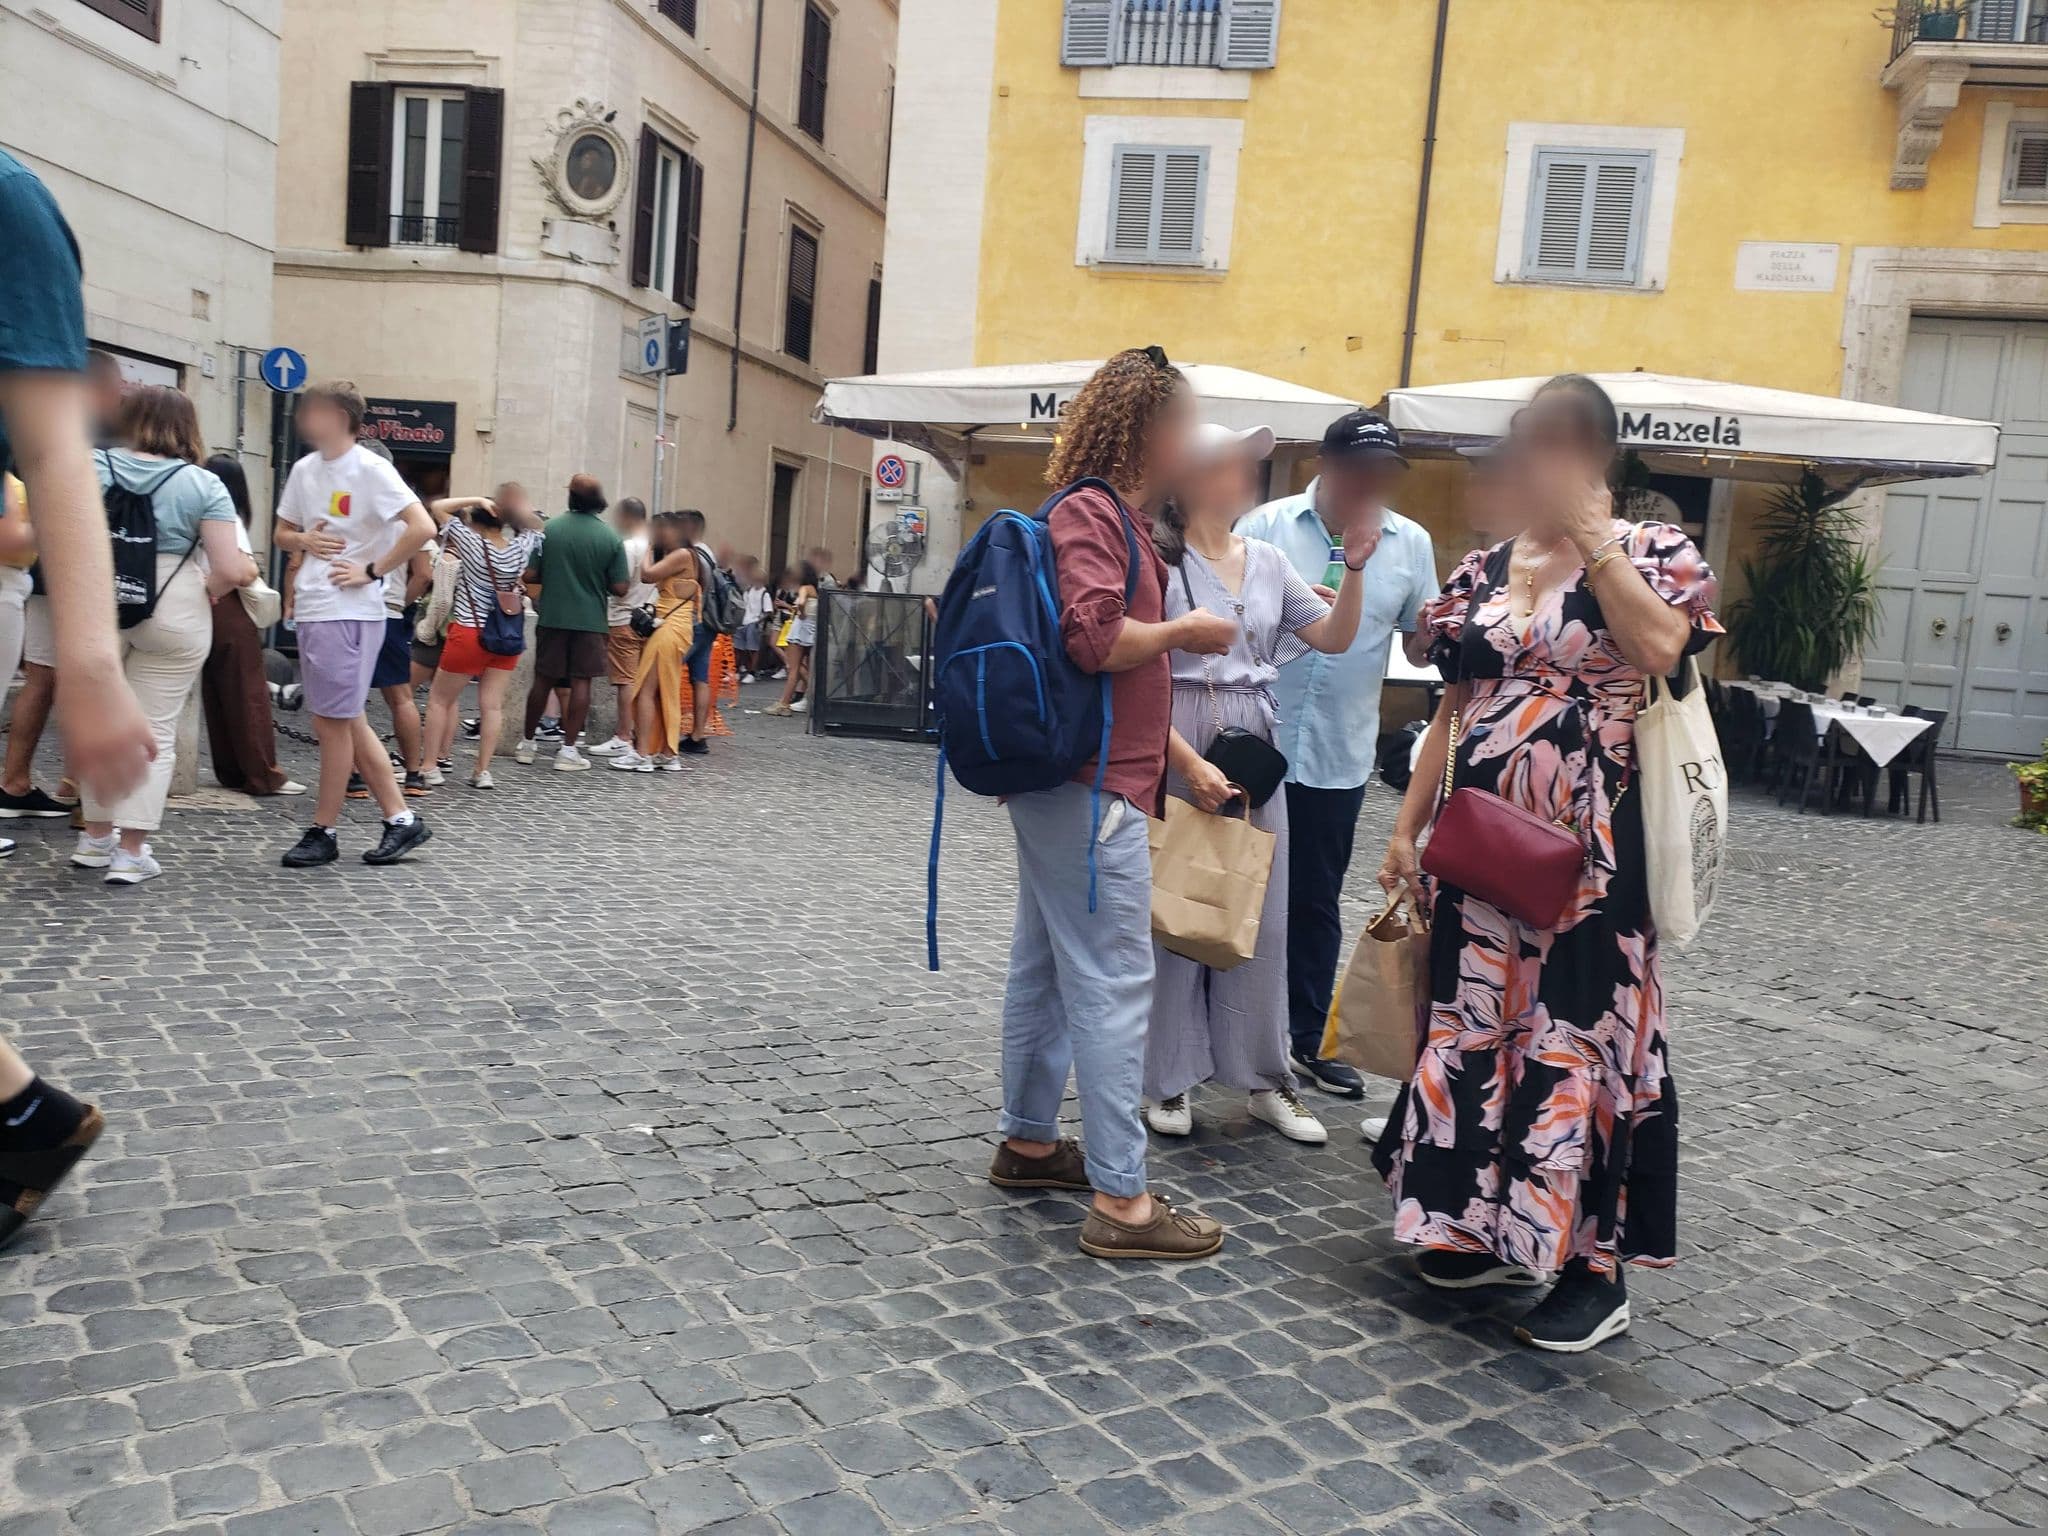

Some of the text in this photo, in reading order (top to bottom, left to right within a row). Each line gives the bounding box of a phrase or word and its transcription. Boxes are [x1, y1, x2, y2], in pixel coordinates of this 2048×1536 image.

[1768, 250, 1806, 259] PIAZZA
[377, 419, 445, 443] Vinaio
[1620, 411, 1741, 446] Maxelâ
